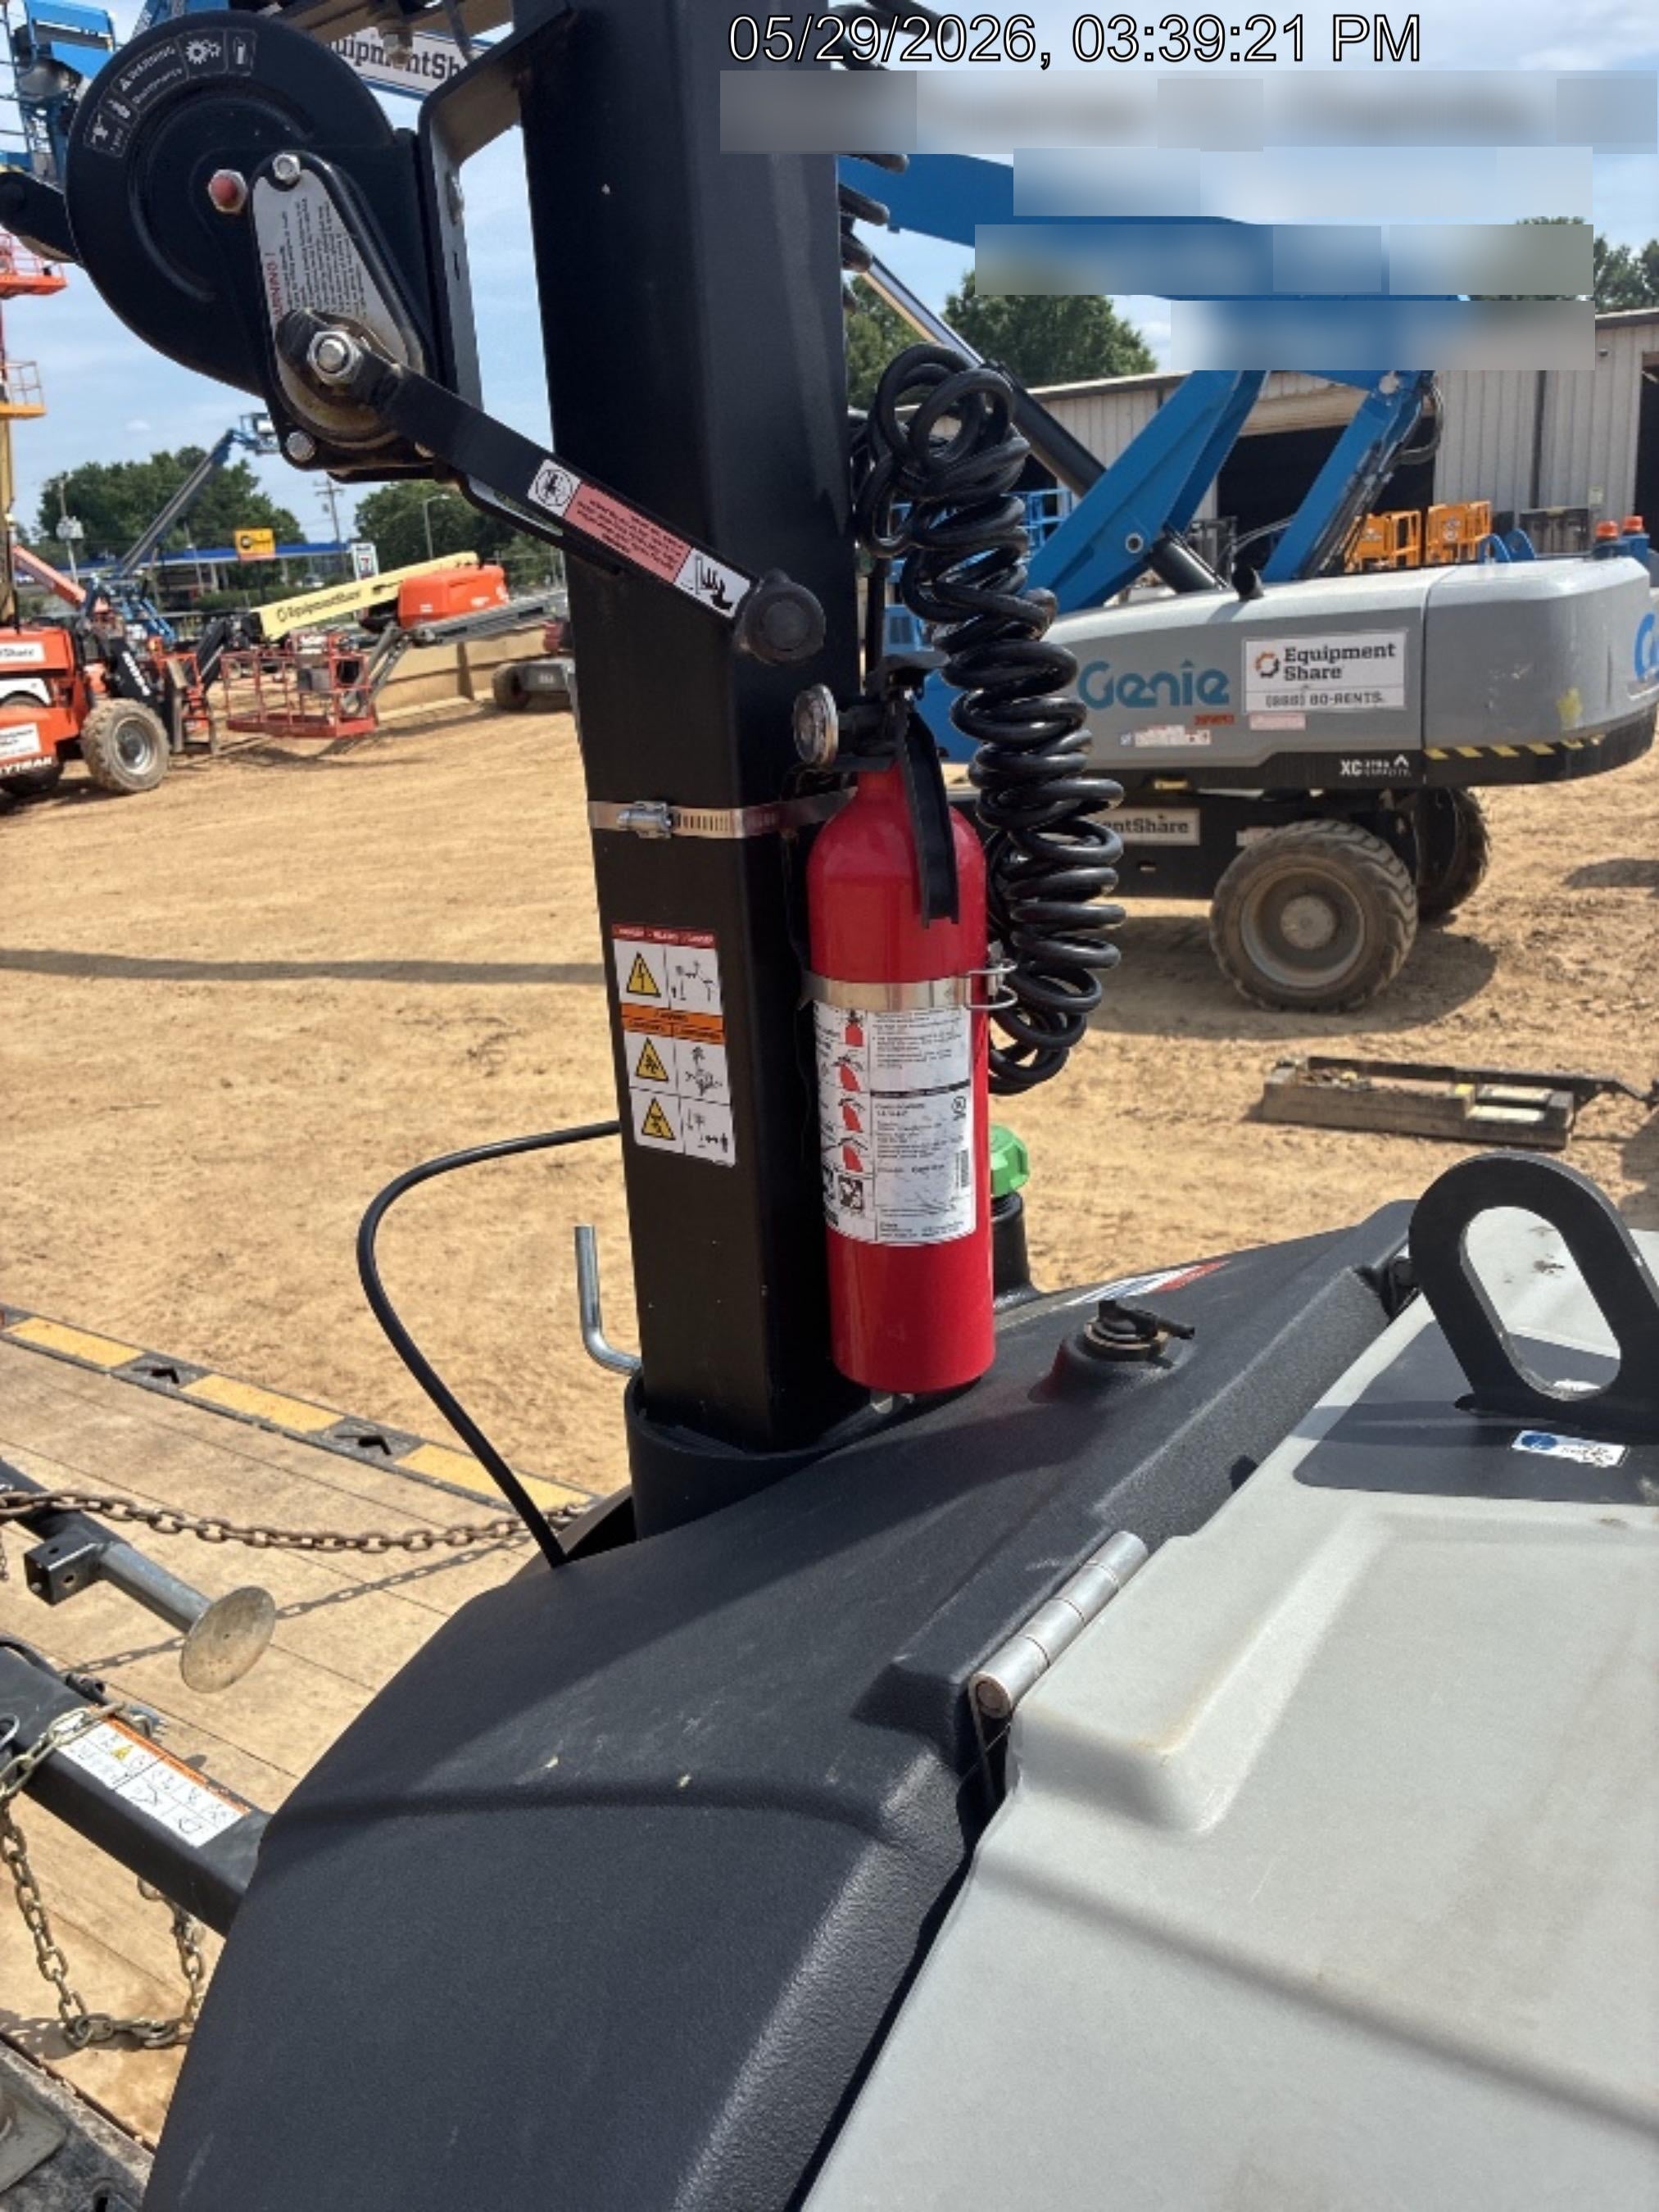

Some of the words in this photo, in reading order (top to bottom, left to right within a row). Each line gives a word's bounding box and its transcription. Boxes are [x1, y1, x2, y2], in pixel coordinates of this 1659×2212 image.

[1284, 642, 1396, 664] Equipment
[1284, 665, 1343, 682] Share
[1077, 658, 1230, 710] Genie
[1340, 759, 1362, 777] XC
